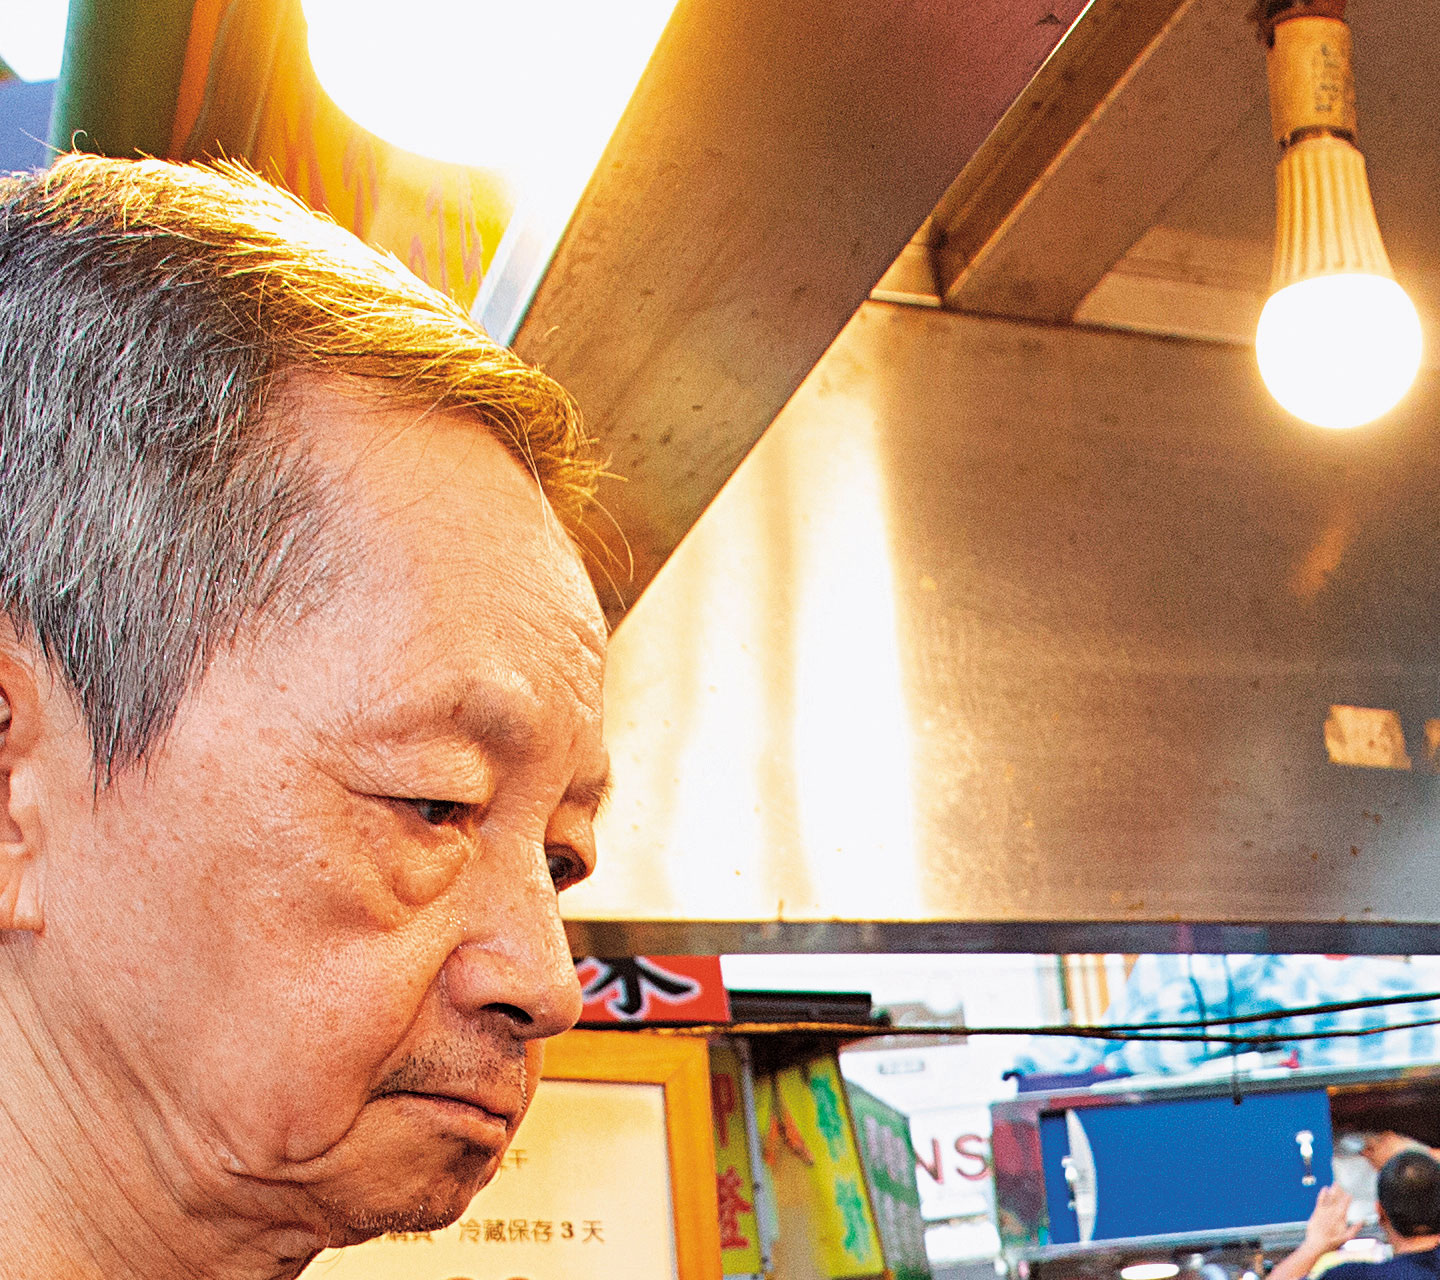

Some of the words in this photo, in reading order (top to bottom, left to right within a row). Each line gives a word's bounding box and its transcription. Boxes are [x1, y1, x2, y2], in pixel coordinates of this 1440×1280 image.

[459, 1219, 553, 1244] 冷藏保存
[561, 1221, 574, 1240] 3
[582, 1219, 605, 1244] 天
